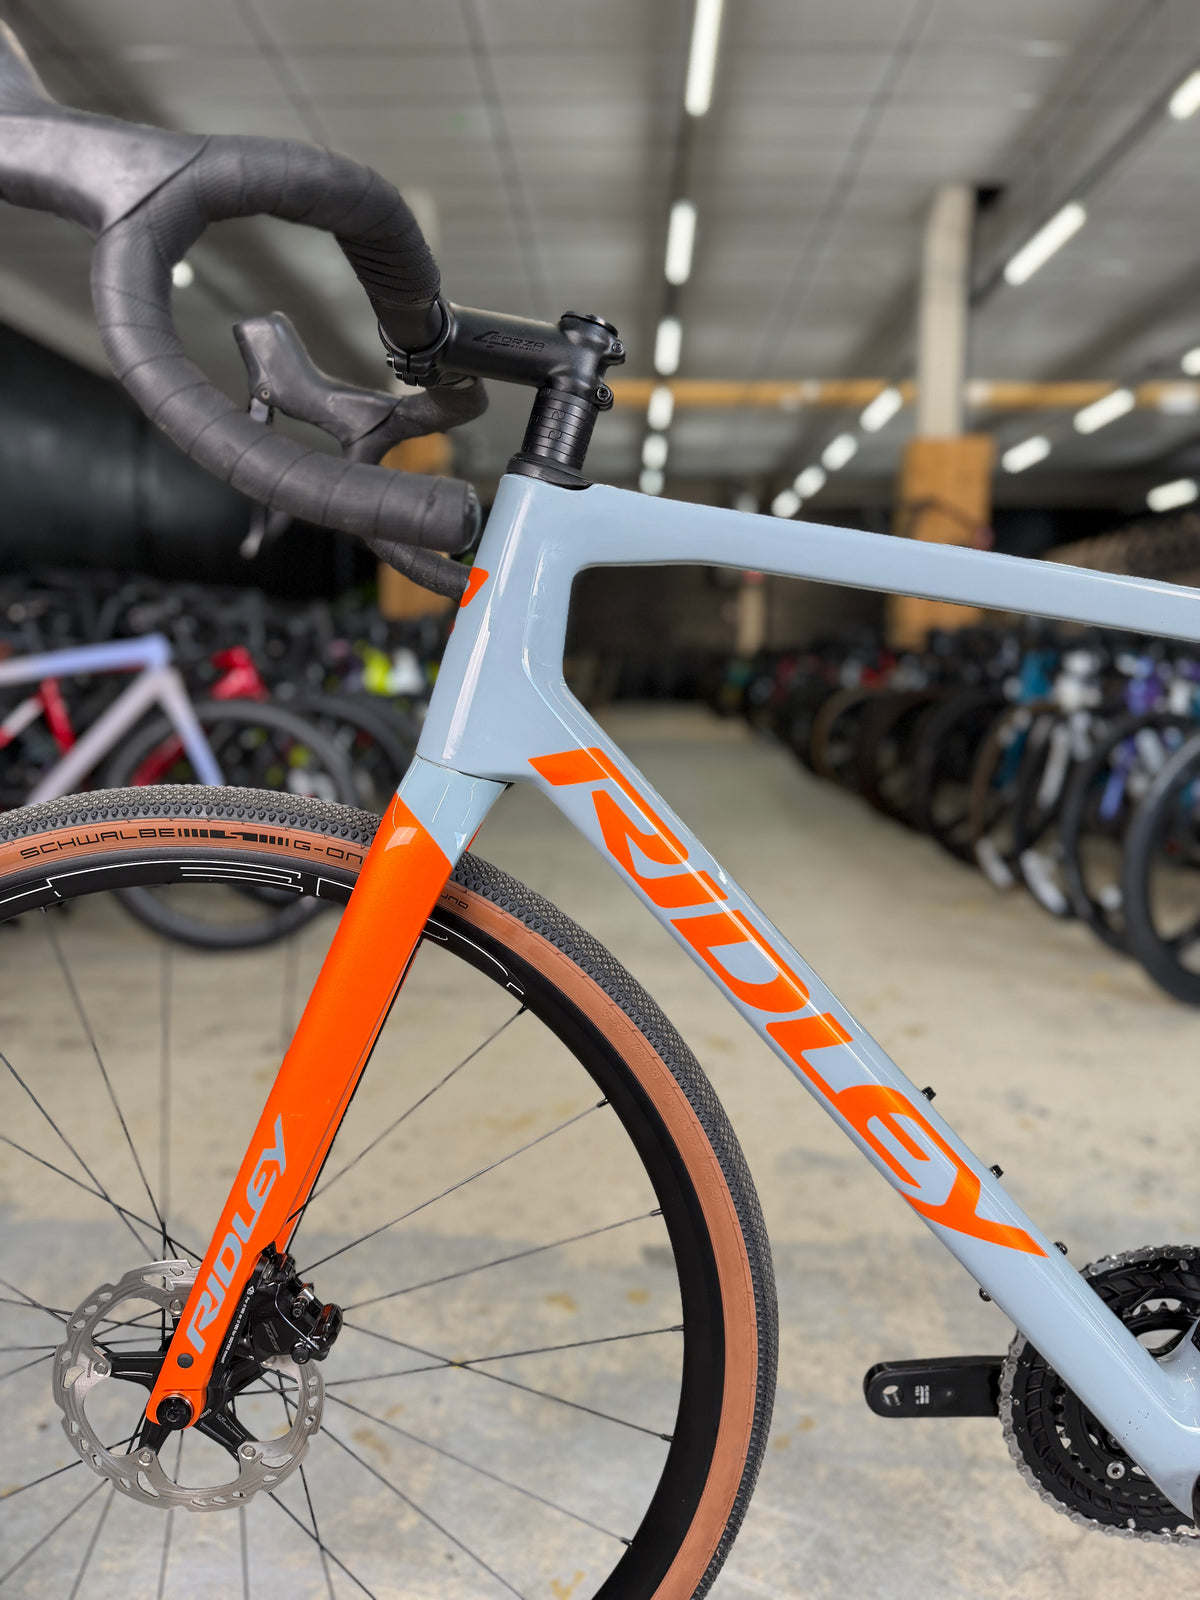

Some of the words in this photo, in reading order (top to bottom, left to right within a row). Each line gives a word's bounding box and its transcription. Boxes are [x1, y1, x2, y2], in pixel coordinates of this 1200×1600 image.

[489, 334, 546, 349] FORZA
[20, 827, 177, 860] SCHWALBE
[293, 840, 365, 866] G-ON
[527, 746, 1050, 1259] RIDLEY
[186, 1112, 287, 1354] RIDLEY
